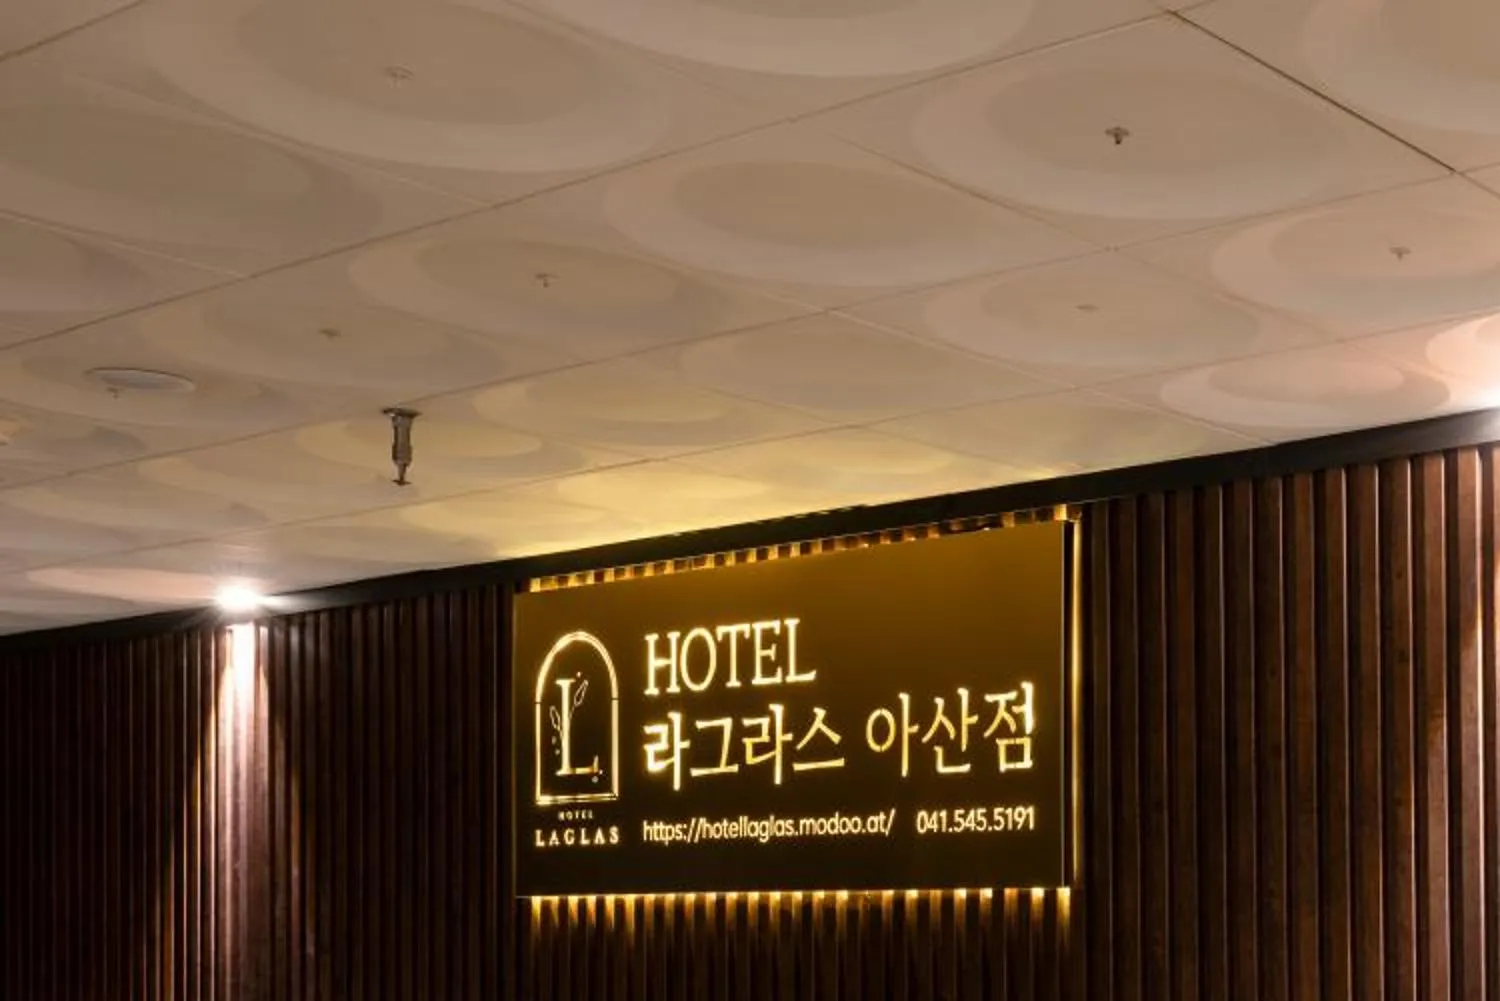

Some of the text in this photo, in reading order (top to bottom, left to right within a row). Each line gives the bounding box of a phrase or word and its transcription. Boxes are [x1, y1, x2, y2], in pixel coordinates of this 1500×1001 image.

[643, 617, 818, 696] HOTEL
[642, 681, 1035, 791] 라그라스 아산점
[535, 825, 620, 847] LAGLAS
[642, 806, 1035, 845] https://hotellaglas.modoo.at/ 041.545.5191
